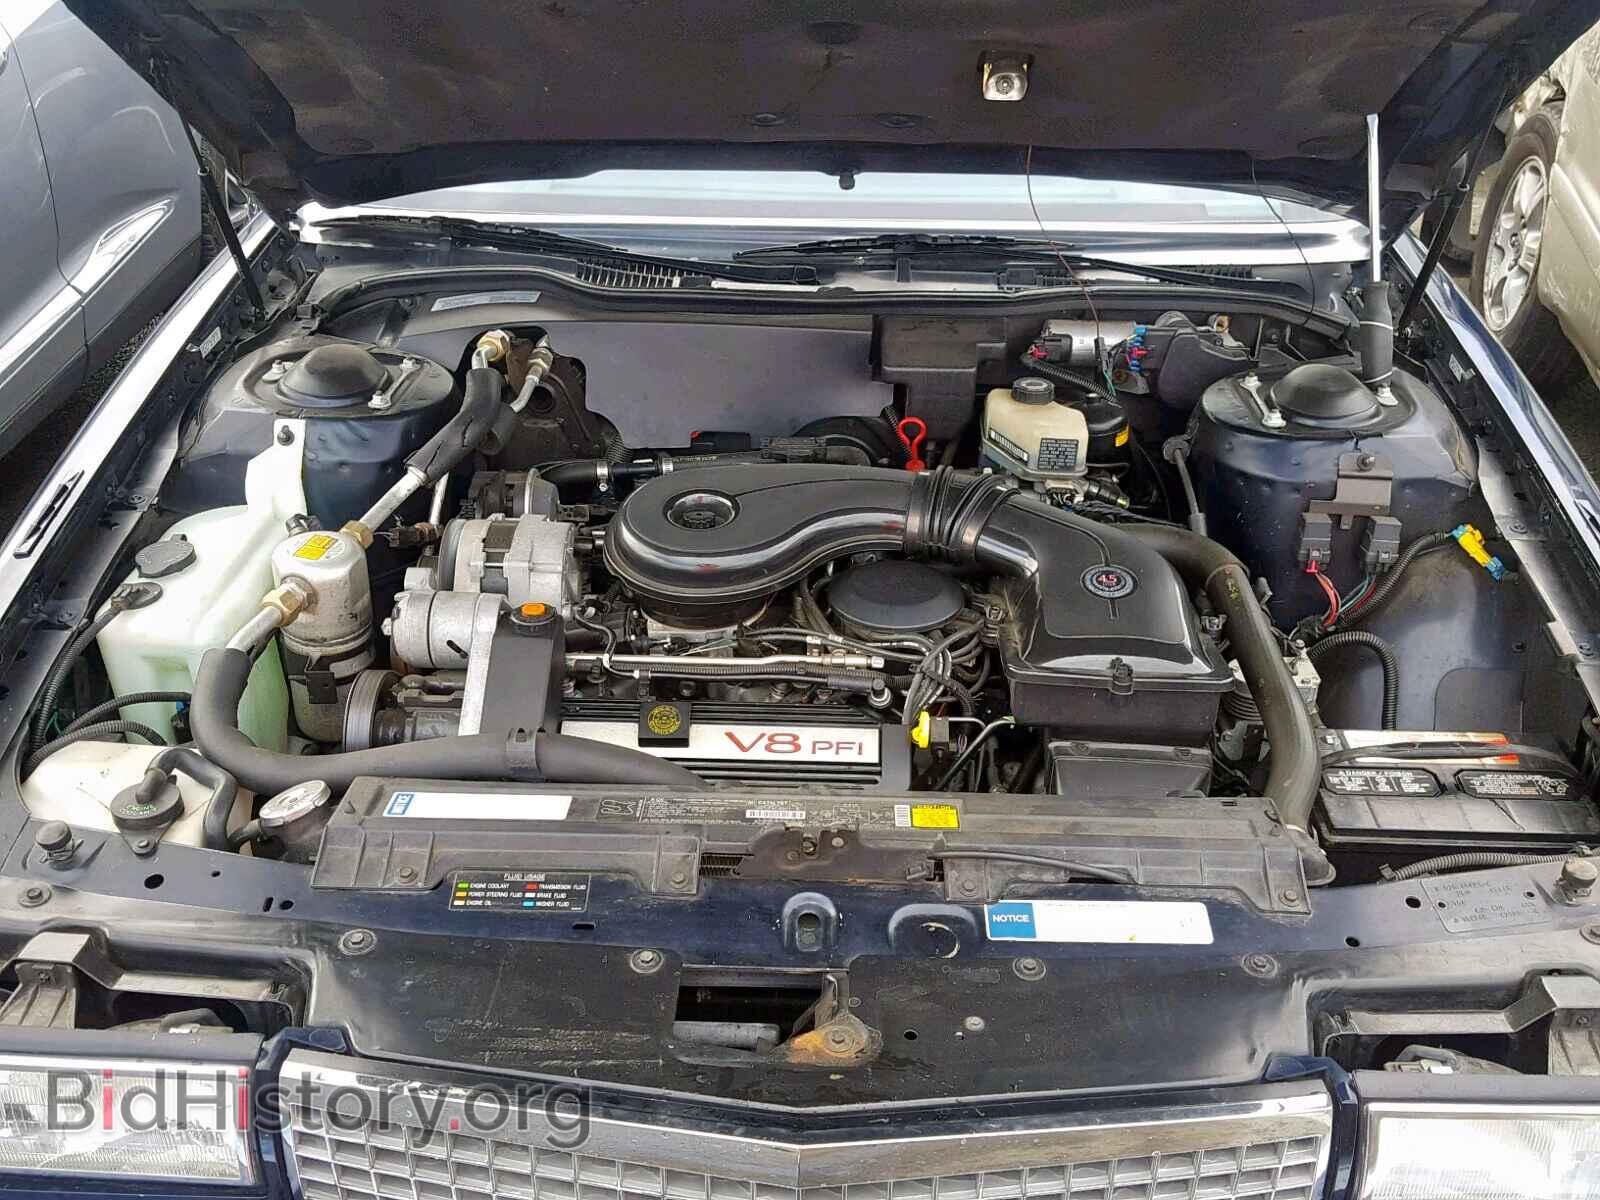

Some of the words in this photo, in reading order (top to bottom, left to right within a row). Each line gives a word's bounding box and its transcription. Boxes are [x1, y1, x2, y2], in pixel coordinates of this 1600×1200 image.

[724, 731, 802, 754] V8
[811, 740, 864, 756] PFI
[503, 872, 523, 881] FLUID
[523, 872, 546, 881] USAGE
[991, 913, 1031, 923] NOTICE
